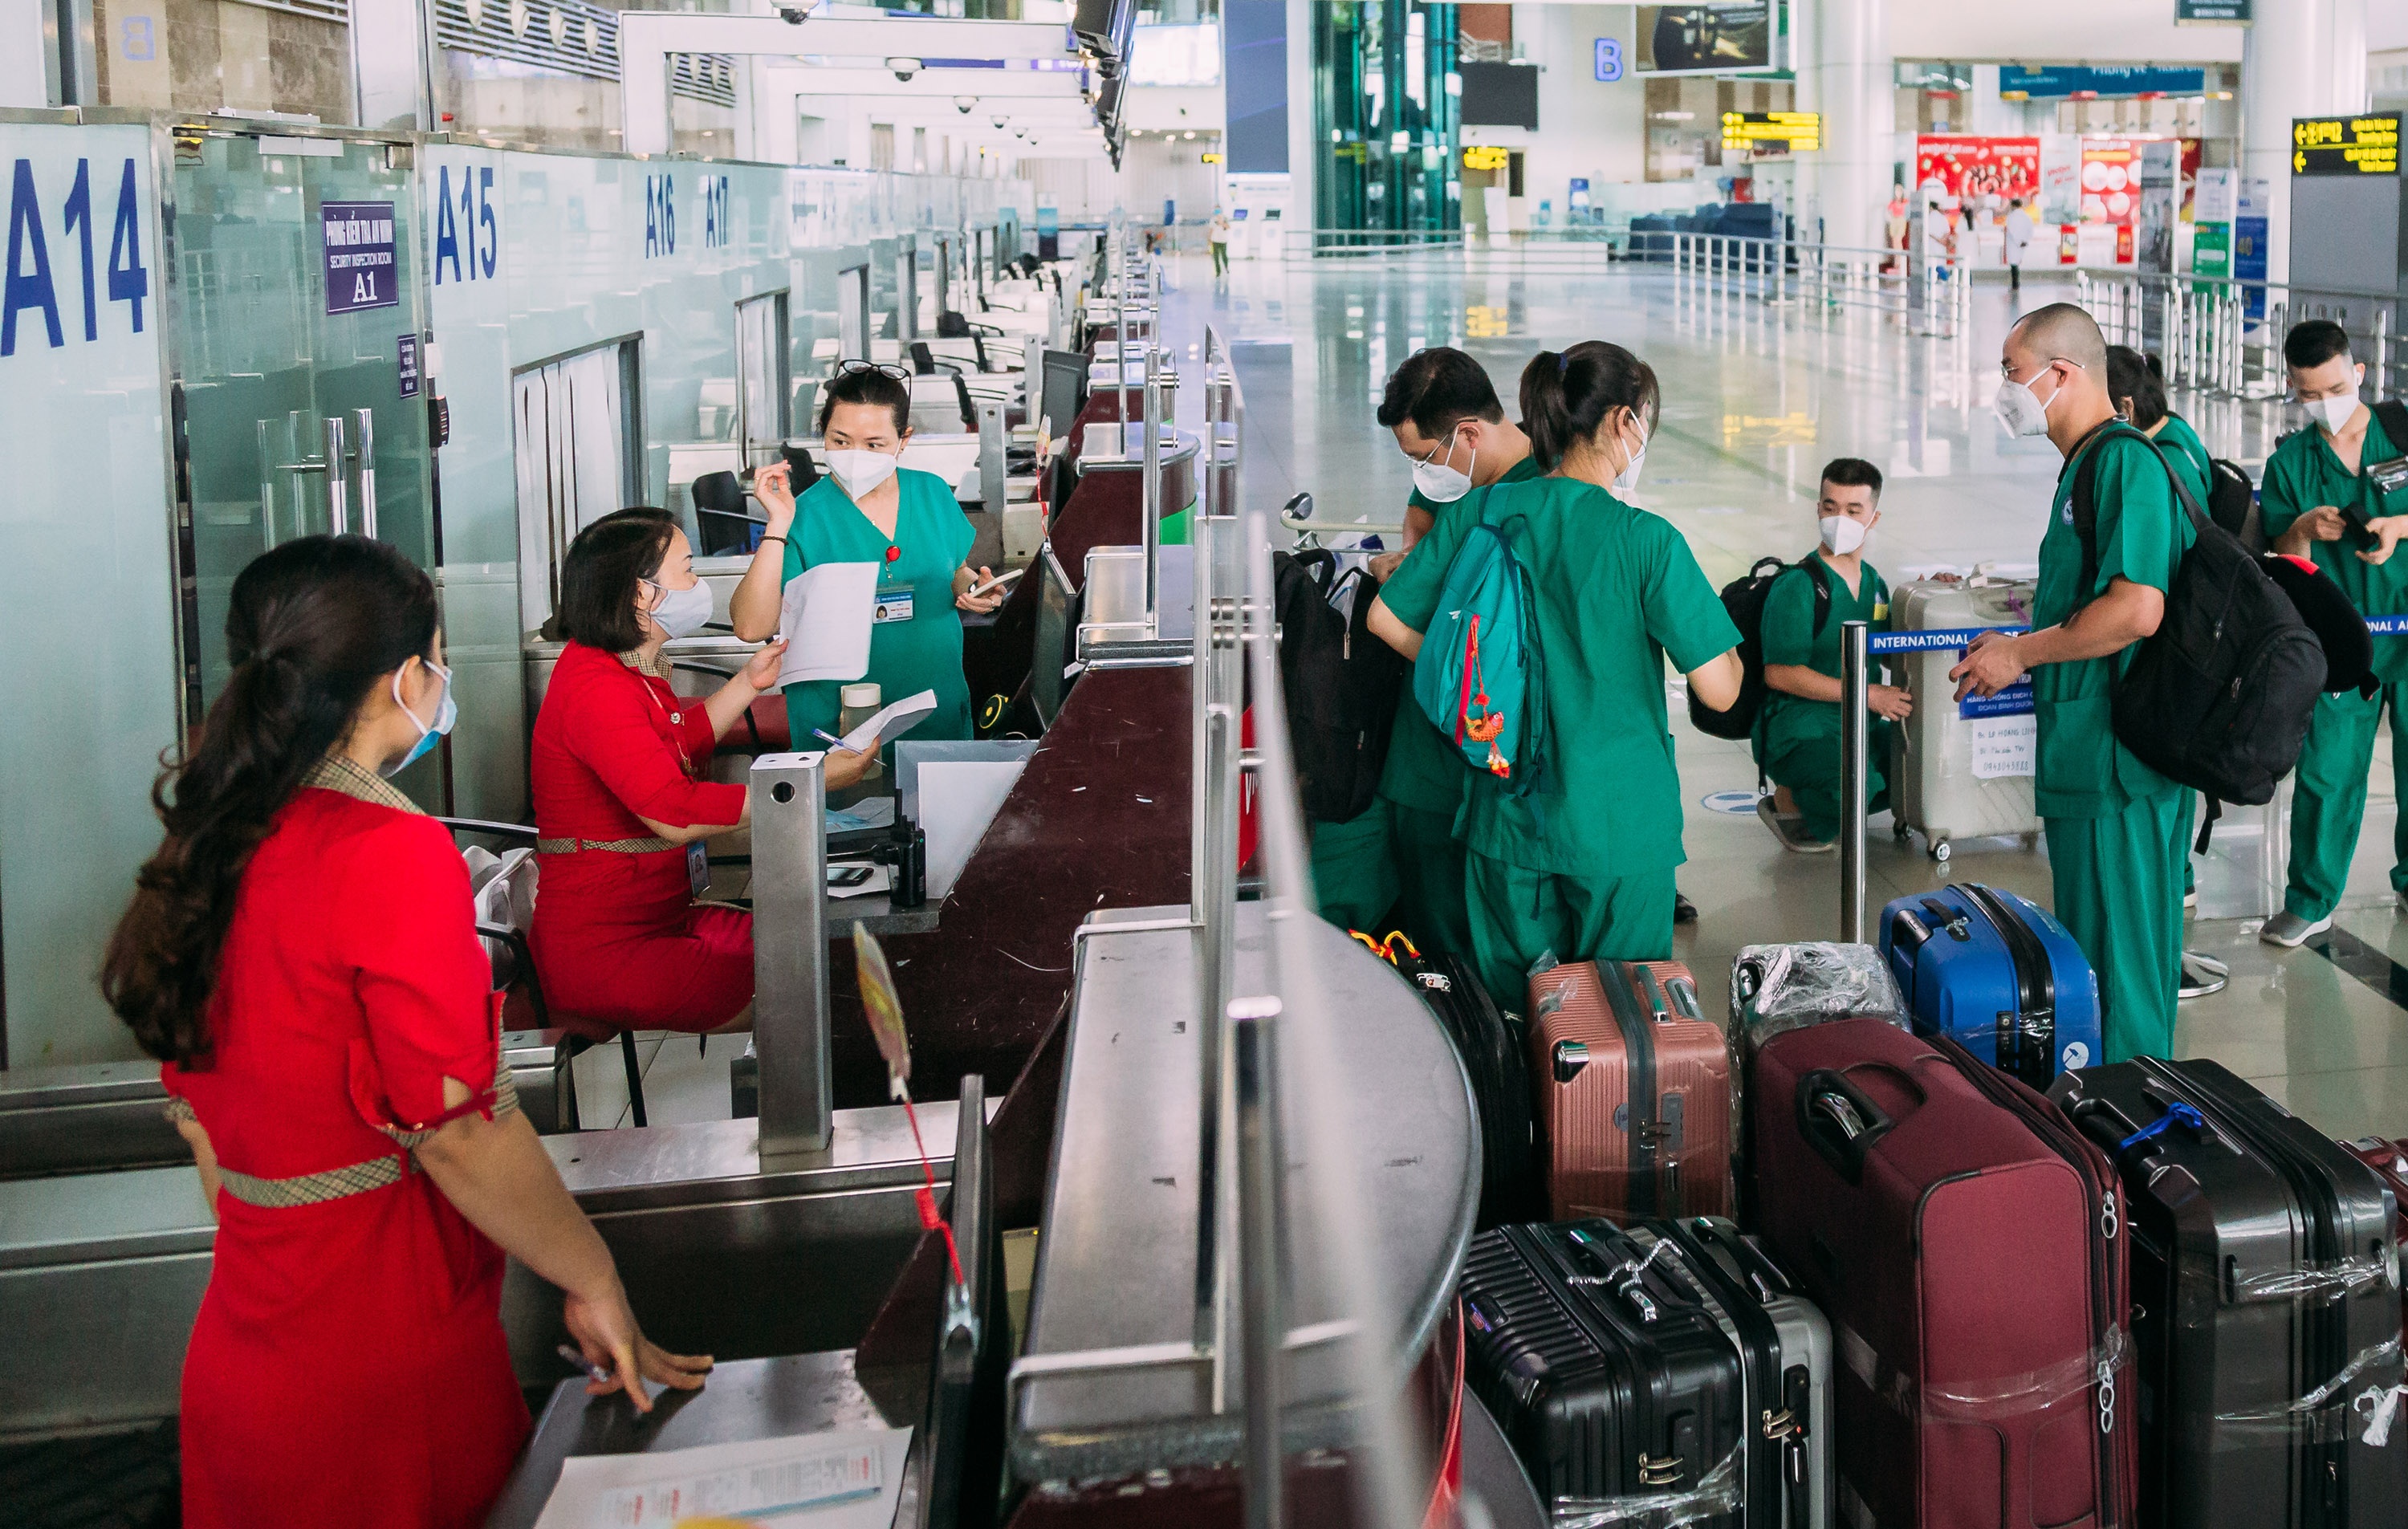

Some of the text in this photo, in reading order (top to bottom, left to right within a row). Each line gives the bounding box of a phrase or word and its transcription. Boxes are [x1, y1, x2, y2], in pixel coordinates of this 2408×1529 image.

[1594, 38, 1623, 82] B
[435, 165, 497, 285] A15
[646, 174, 674, 259] A16
[706, 175, 728, 248] A17
[1, 158, 148, 357] A14
[353, 271, 378, 303] A1
[1873, 633, 1970, 649] INTERNATIONAL
